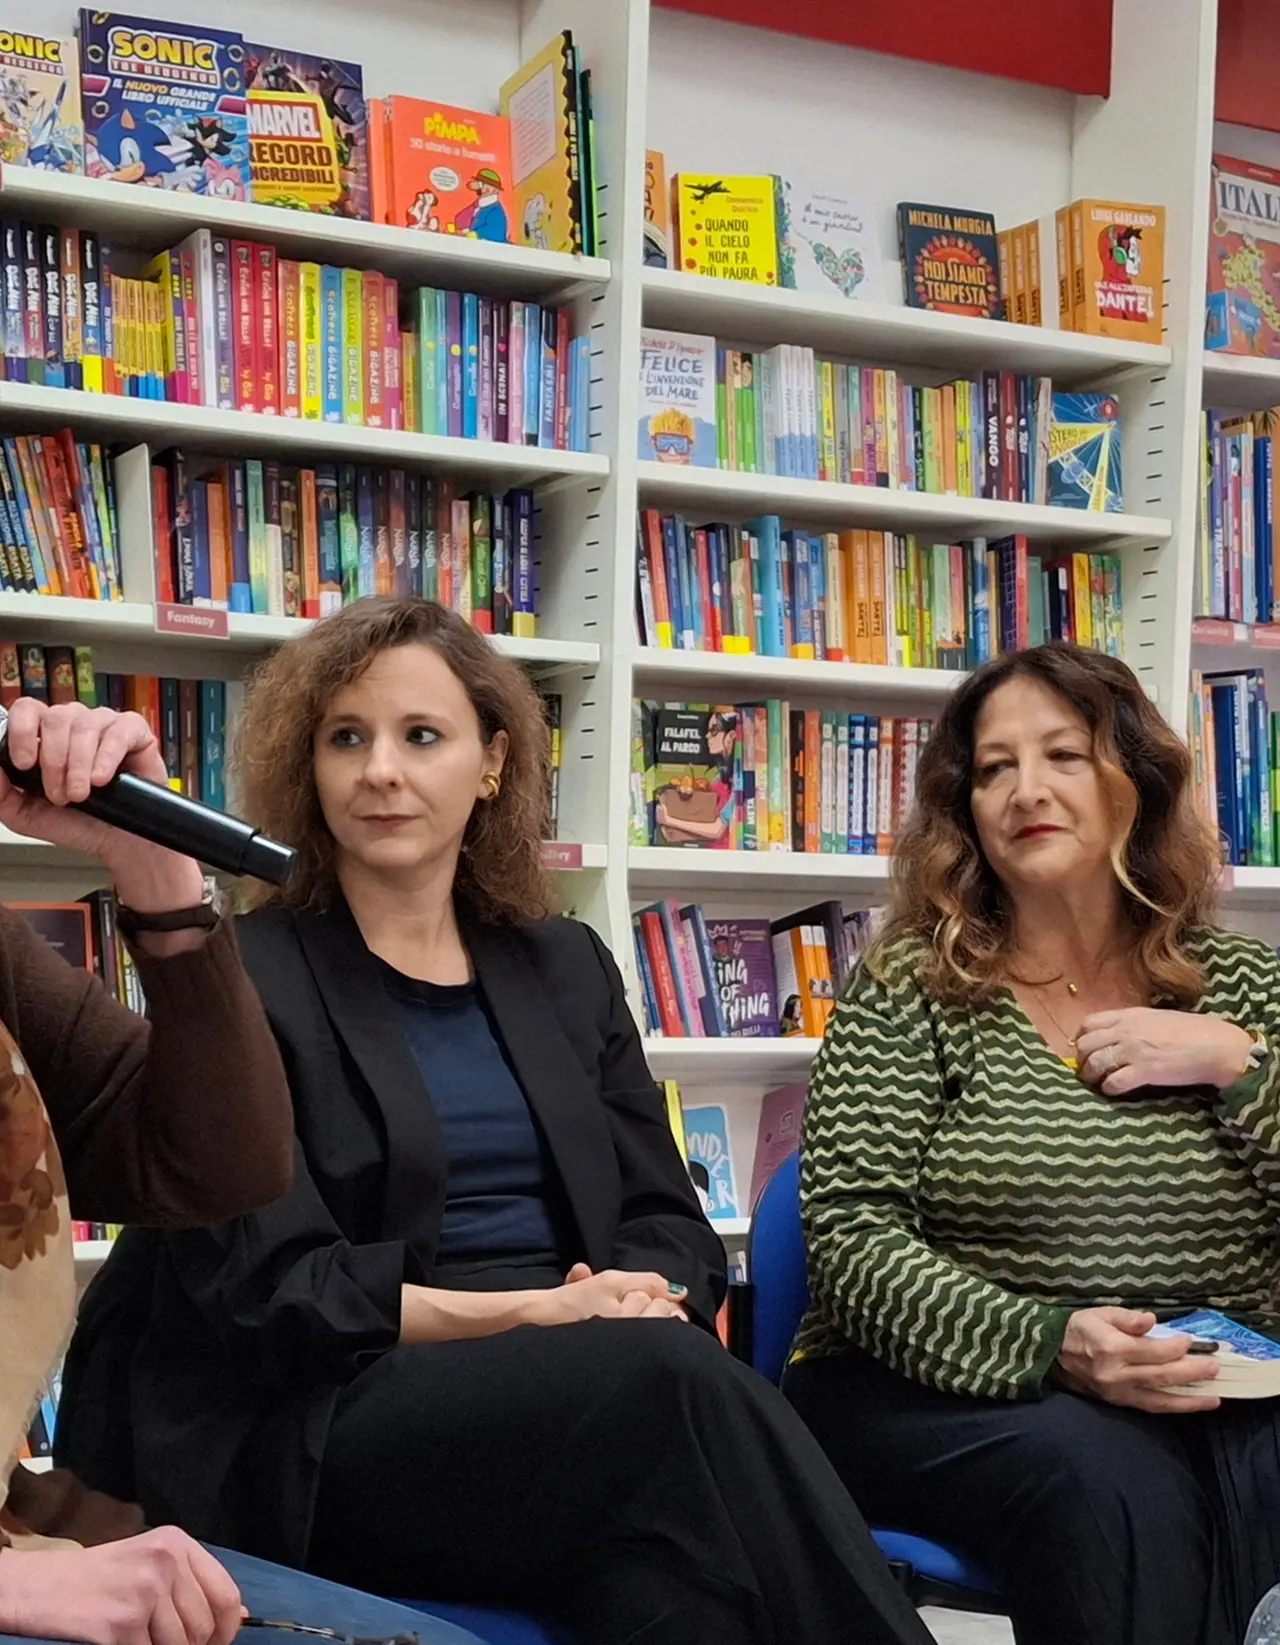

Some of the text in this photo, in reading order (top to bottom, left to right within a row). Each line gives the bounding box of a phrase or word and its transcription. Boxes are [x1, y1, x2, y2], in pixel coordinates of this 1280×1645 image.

[112, 31, 216, 68] SONIC
[2, 56, 64, 75] HEDGEHOG
[143, 63, 217, 85] HEDGEHOG
[122, 90, 209, 110] LIBRO UFFICIALE
[125, 80, 168, 95] NUOVO
[170, 86, 217, 103] GRANDE
[246, 103, 320, 138] MARVEL
[251, 166, 335, 185] NCREDIBILI
[909, 209, 993, 236] MICHELA MURGIA
[1091, 209, 1113, 222] LUIGI
[705, 219, 748, 233] QUANDO
[705, 235, 750, 248] IL CIELO
[708, 251, 749, 264] NON FA
[722, 265, 758, 280] PAURA
[923, 257, 986, 286] NOI SIAMO
[926, 280, 987, 307] TEMPESTA
[1096, 291, 1155, 318] DANTE!
[640, 350, 704, 374] FELICE
[645, 386, 701, 401] DEL MARE
[987, 416, 999, 467] VANGO
[164, 607, 217, 628] Fantasy
[664, 727, 701, 739] FALAFEL
[660, 741, 701, 754] AL PARCO
[718, 958, 749, 986] ING
[721, 983, 740, 999] OF
